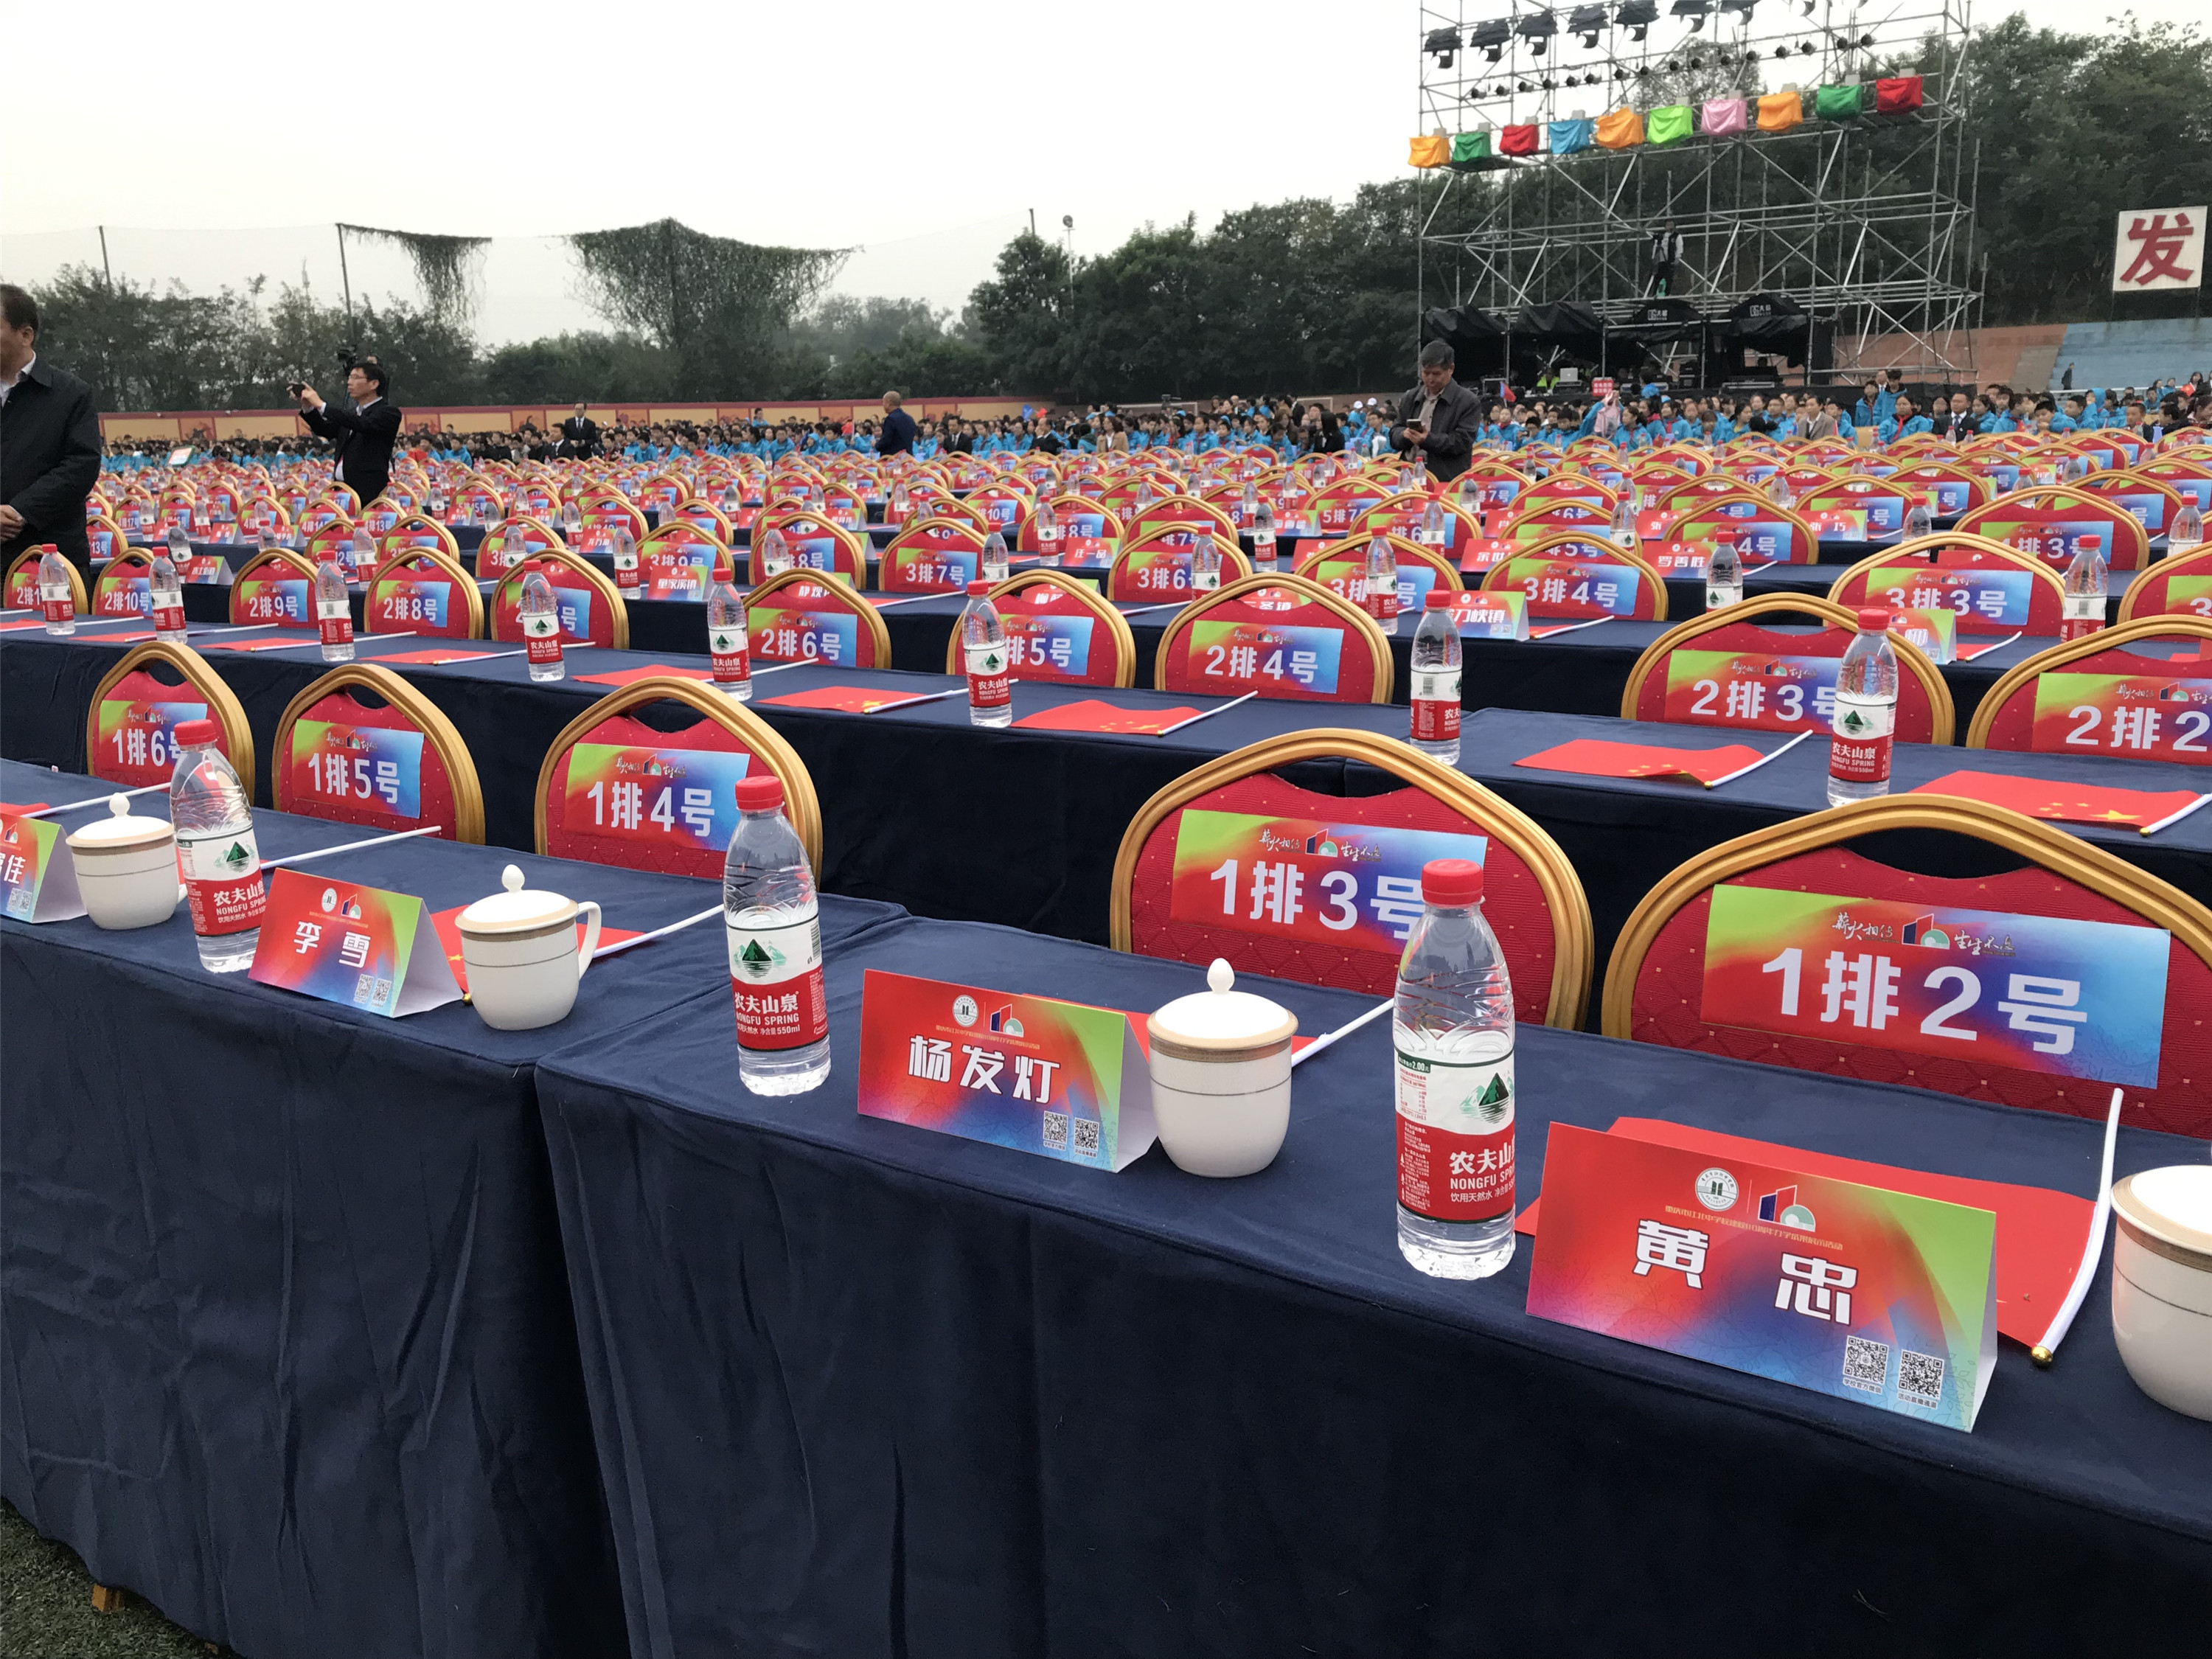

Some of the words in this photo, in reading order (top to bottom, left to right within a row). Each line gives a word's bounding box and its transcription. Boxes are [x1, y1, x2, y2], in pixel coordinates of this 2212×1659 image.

[2119, 212, 2194, 286] 发
[905, 563, 964, 585] 3排7号
[1658, 555, 1705, 568] 罗善胜
[1138, 567, 1192, 589] 3排6
[1330, 578, 1416, 605] 3排号
[105, 591, 150, 612] 2排10号
[1523, 577, 1618, 608] 3排4号
[1886, 588, 2007, 618] 3排3号
[249, 595, 299, 618] 2排9号
[383, 597, 438, 622] 2排8号
[761, 628, 841, 661] 2排6号
[1205, 645, 1318, 684] 2排4号
[1691, 679, 1836, 725] 2排3号
[2066, 705, 2211, 752] 2排2
[1832, 741, 1876, 759] 农夫山泉
[1851, 759, 1875, 767] SPRING
[308, 753, 400, 804] 1排5号
[587, 781, 715, 837] 1排4号
[0, 852, 26, 884] 佳
[213, 880, 265, 906] 农夫山泉
[1210, 858, 1426, 942] 1排3号
[216, 902, 248, 916] NONGFU
[293, 920, 372, 969] 李雪
[734, 990, 799, 1015] 农夫山泉
[1761, 947, 2087, 1055] 1排2号
[759, 1023, 800, 1035] 净含量550ml
[765, 1012, 799, 1026] SPRING
[908, 1034, 1061, 1104] 杨发灯
[1450, 1134, 1515, 1175] 农夫山
[1450, 1172, 1497, 1190] NONGFU
[1450, 1191, 1493, 1203] 饮用天然水
